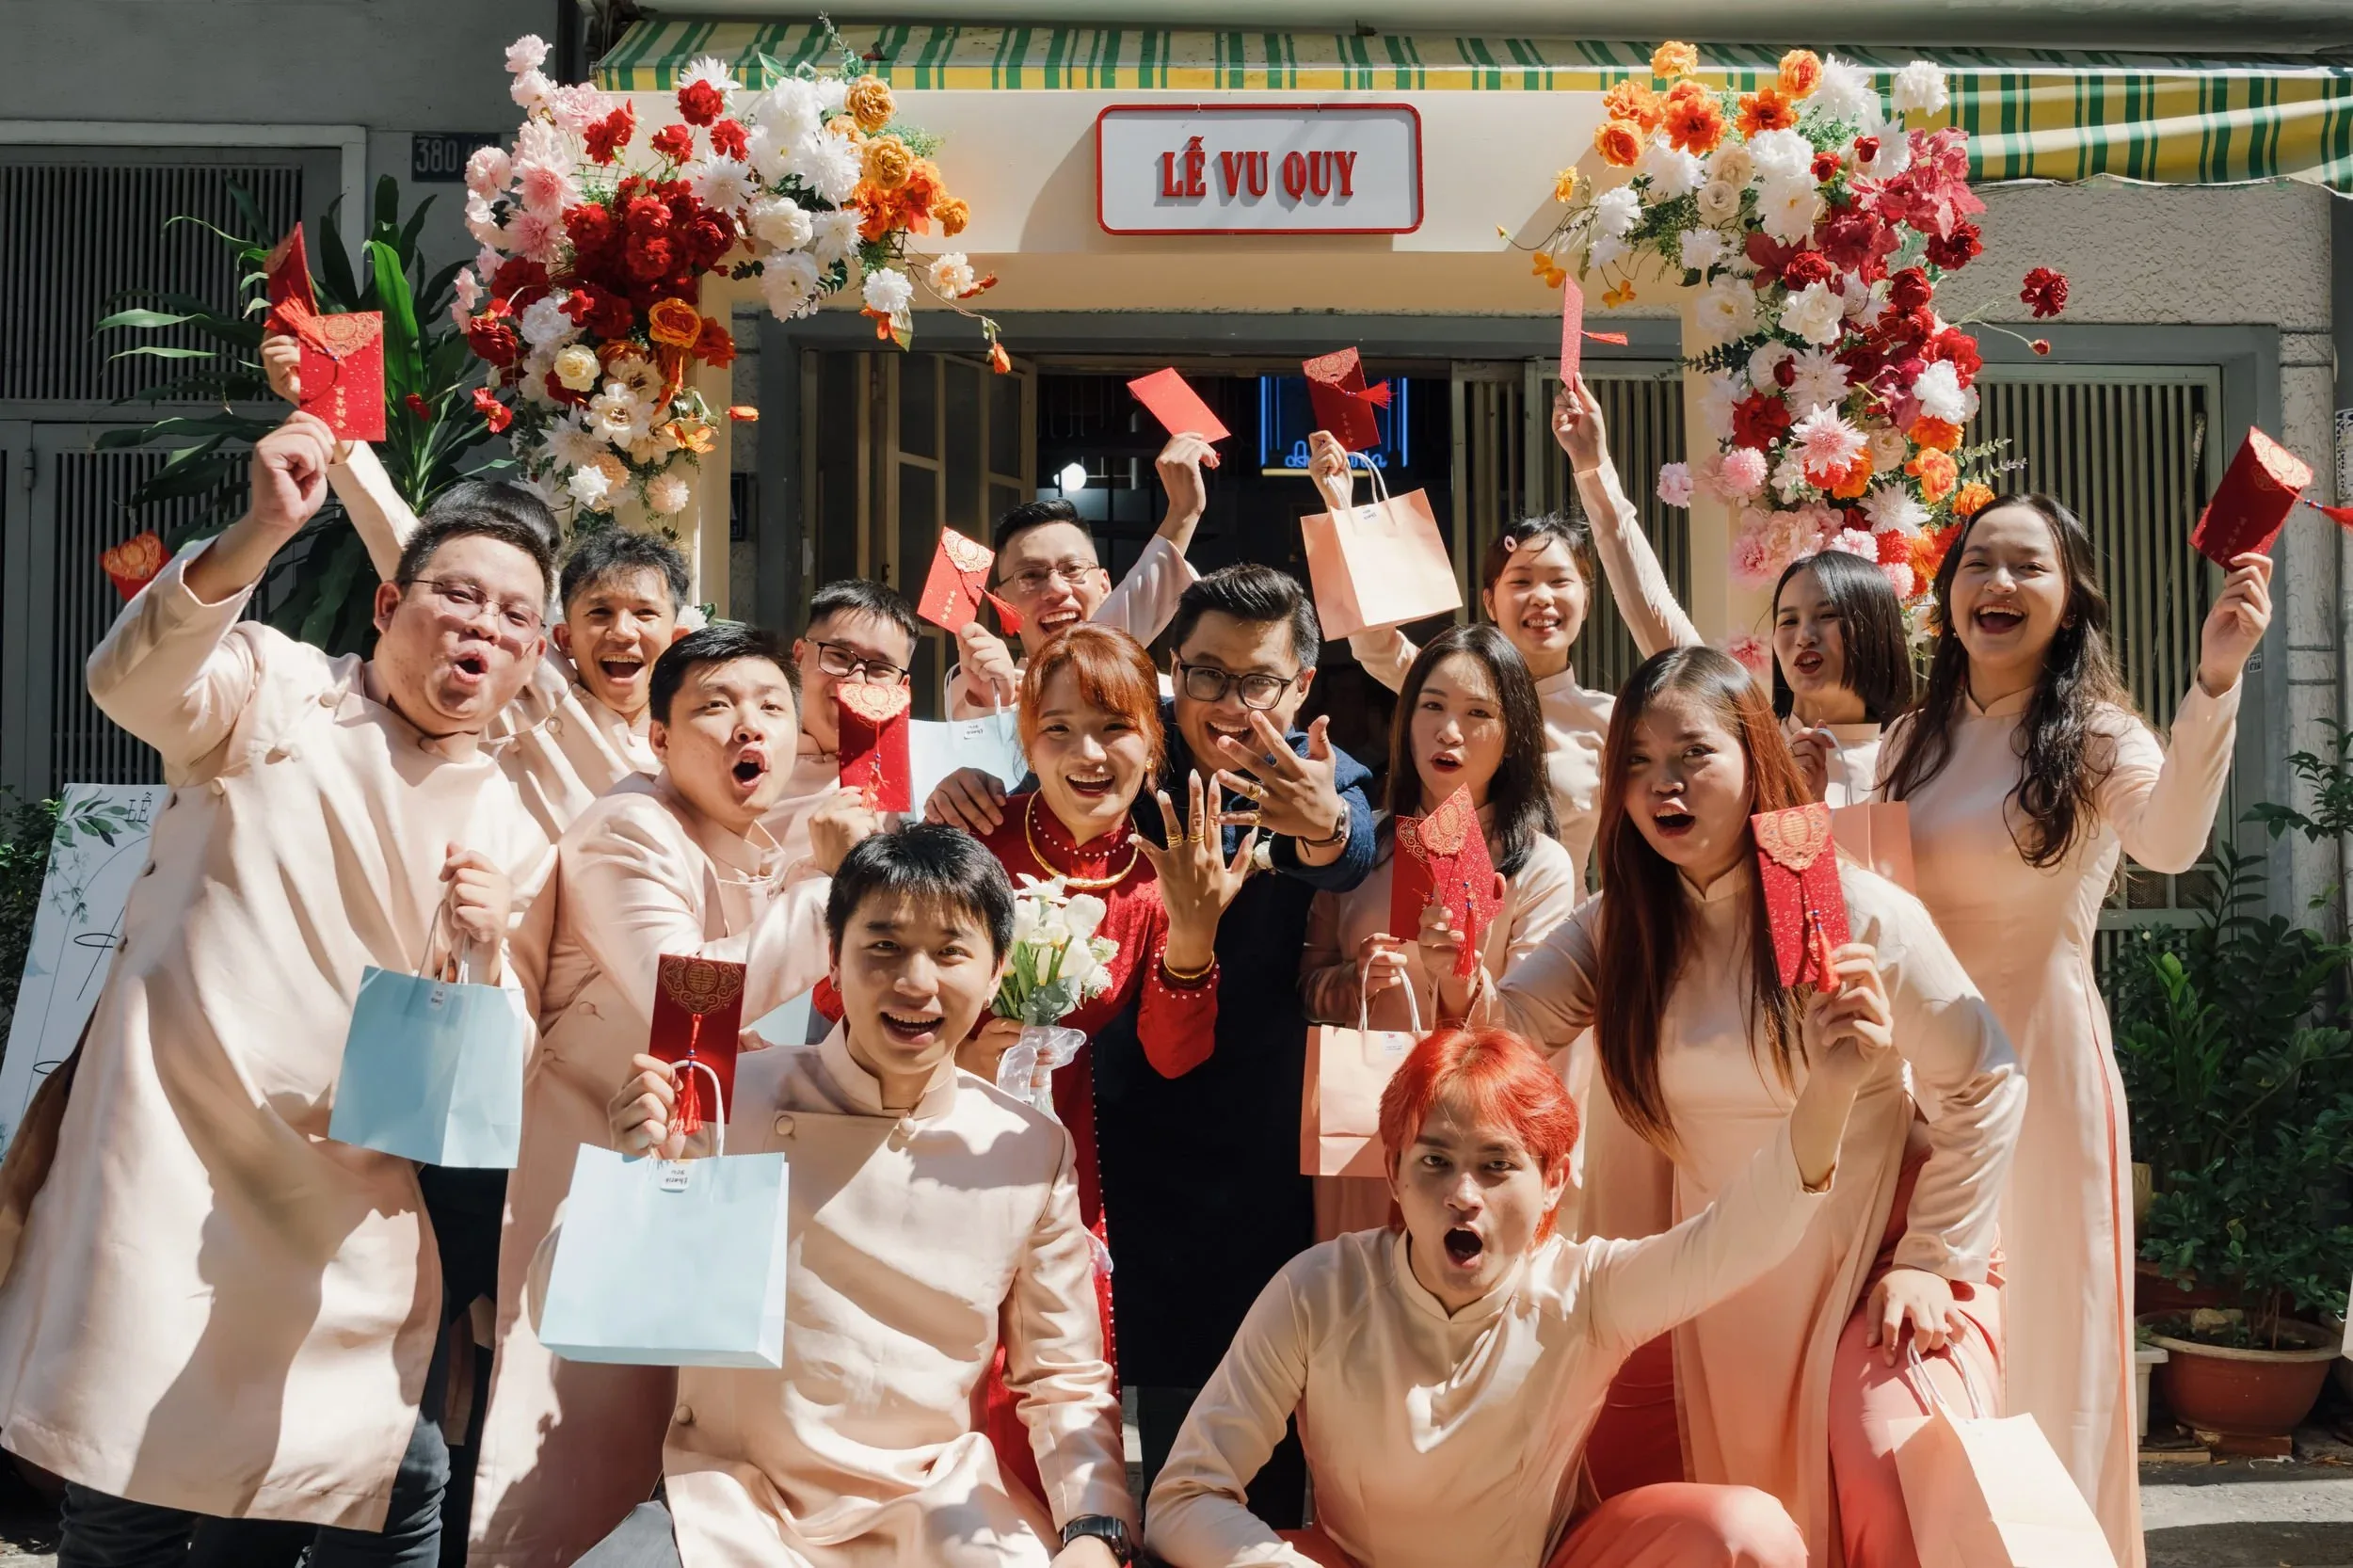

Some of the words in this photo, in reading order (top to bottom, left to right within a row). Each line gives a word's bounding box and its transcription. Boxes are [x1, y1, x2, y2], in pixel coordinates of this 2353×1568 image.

[416, 138, 458, 172] 380
[1221, 151, 1269, 197] VU
[1283, 151, 1357, 200] QUY
[124, 792, 152, 823] LỄ
